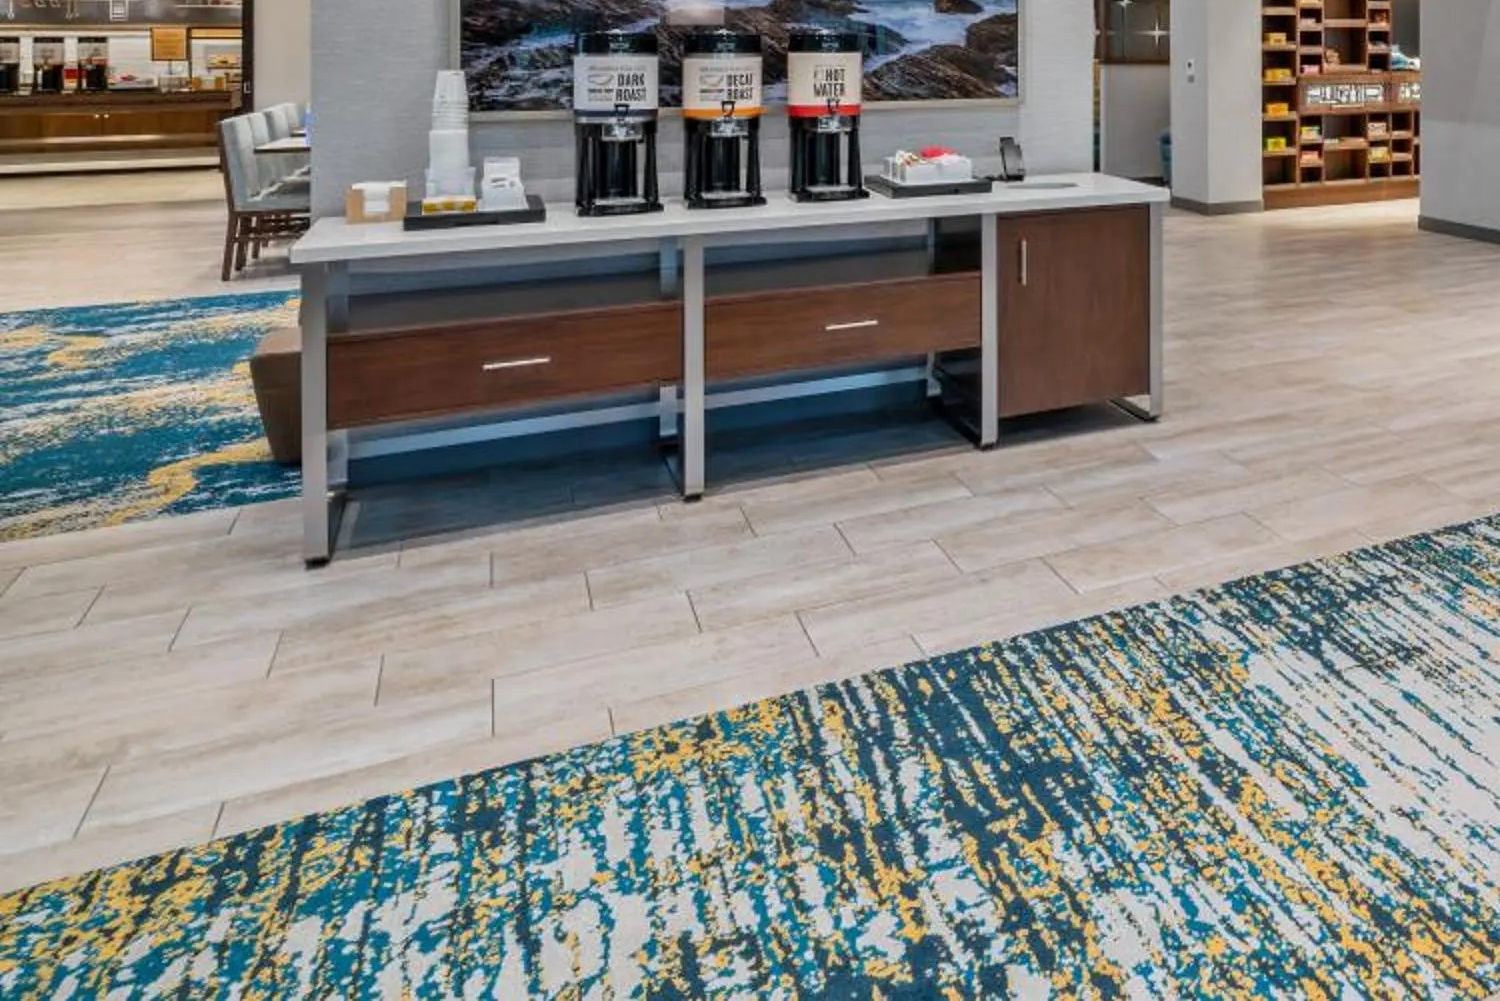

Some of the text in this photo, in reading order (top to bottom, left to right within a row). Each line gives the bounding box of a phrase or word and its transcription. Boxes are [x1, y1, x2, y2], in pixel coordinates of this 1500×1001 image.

[617, 73, 645, 86] DARK
[825, 68, 845, 82] HOT
[615, 88, 647, 101] ROAST
[813, 82, 845, 97] WATER
